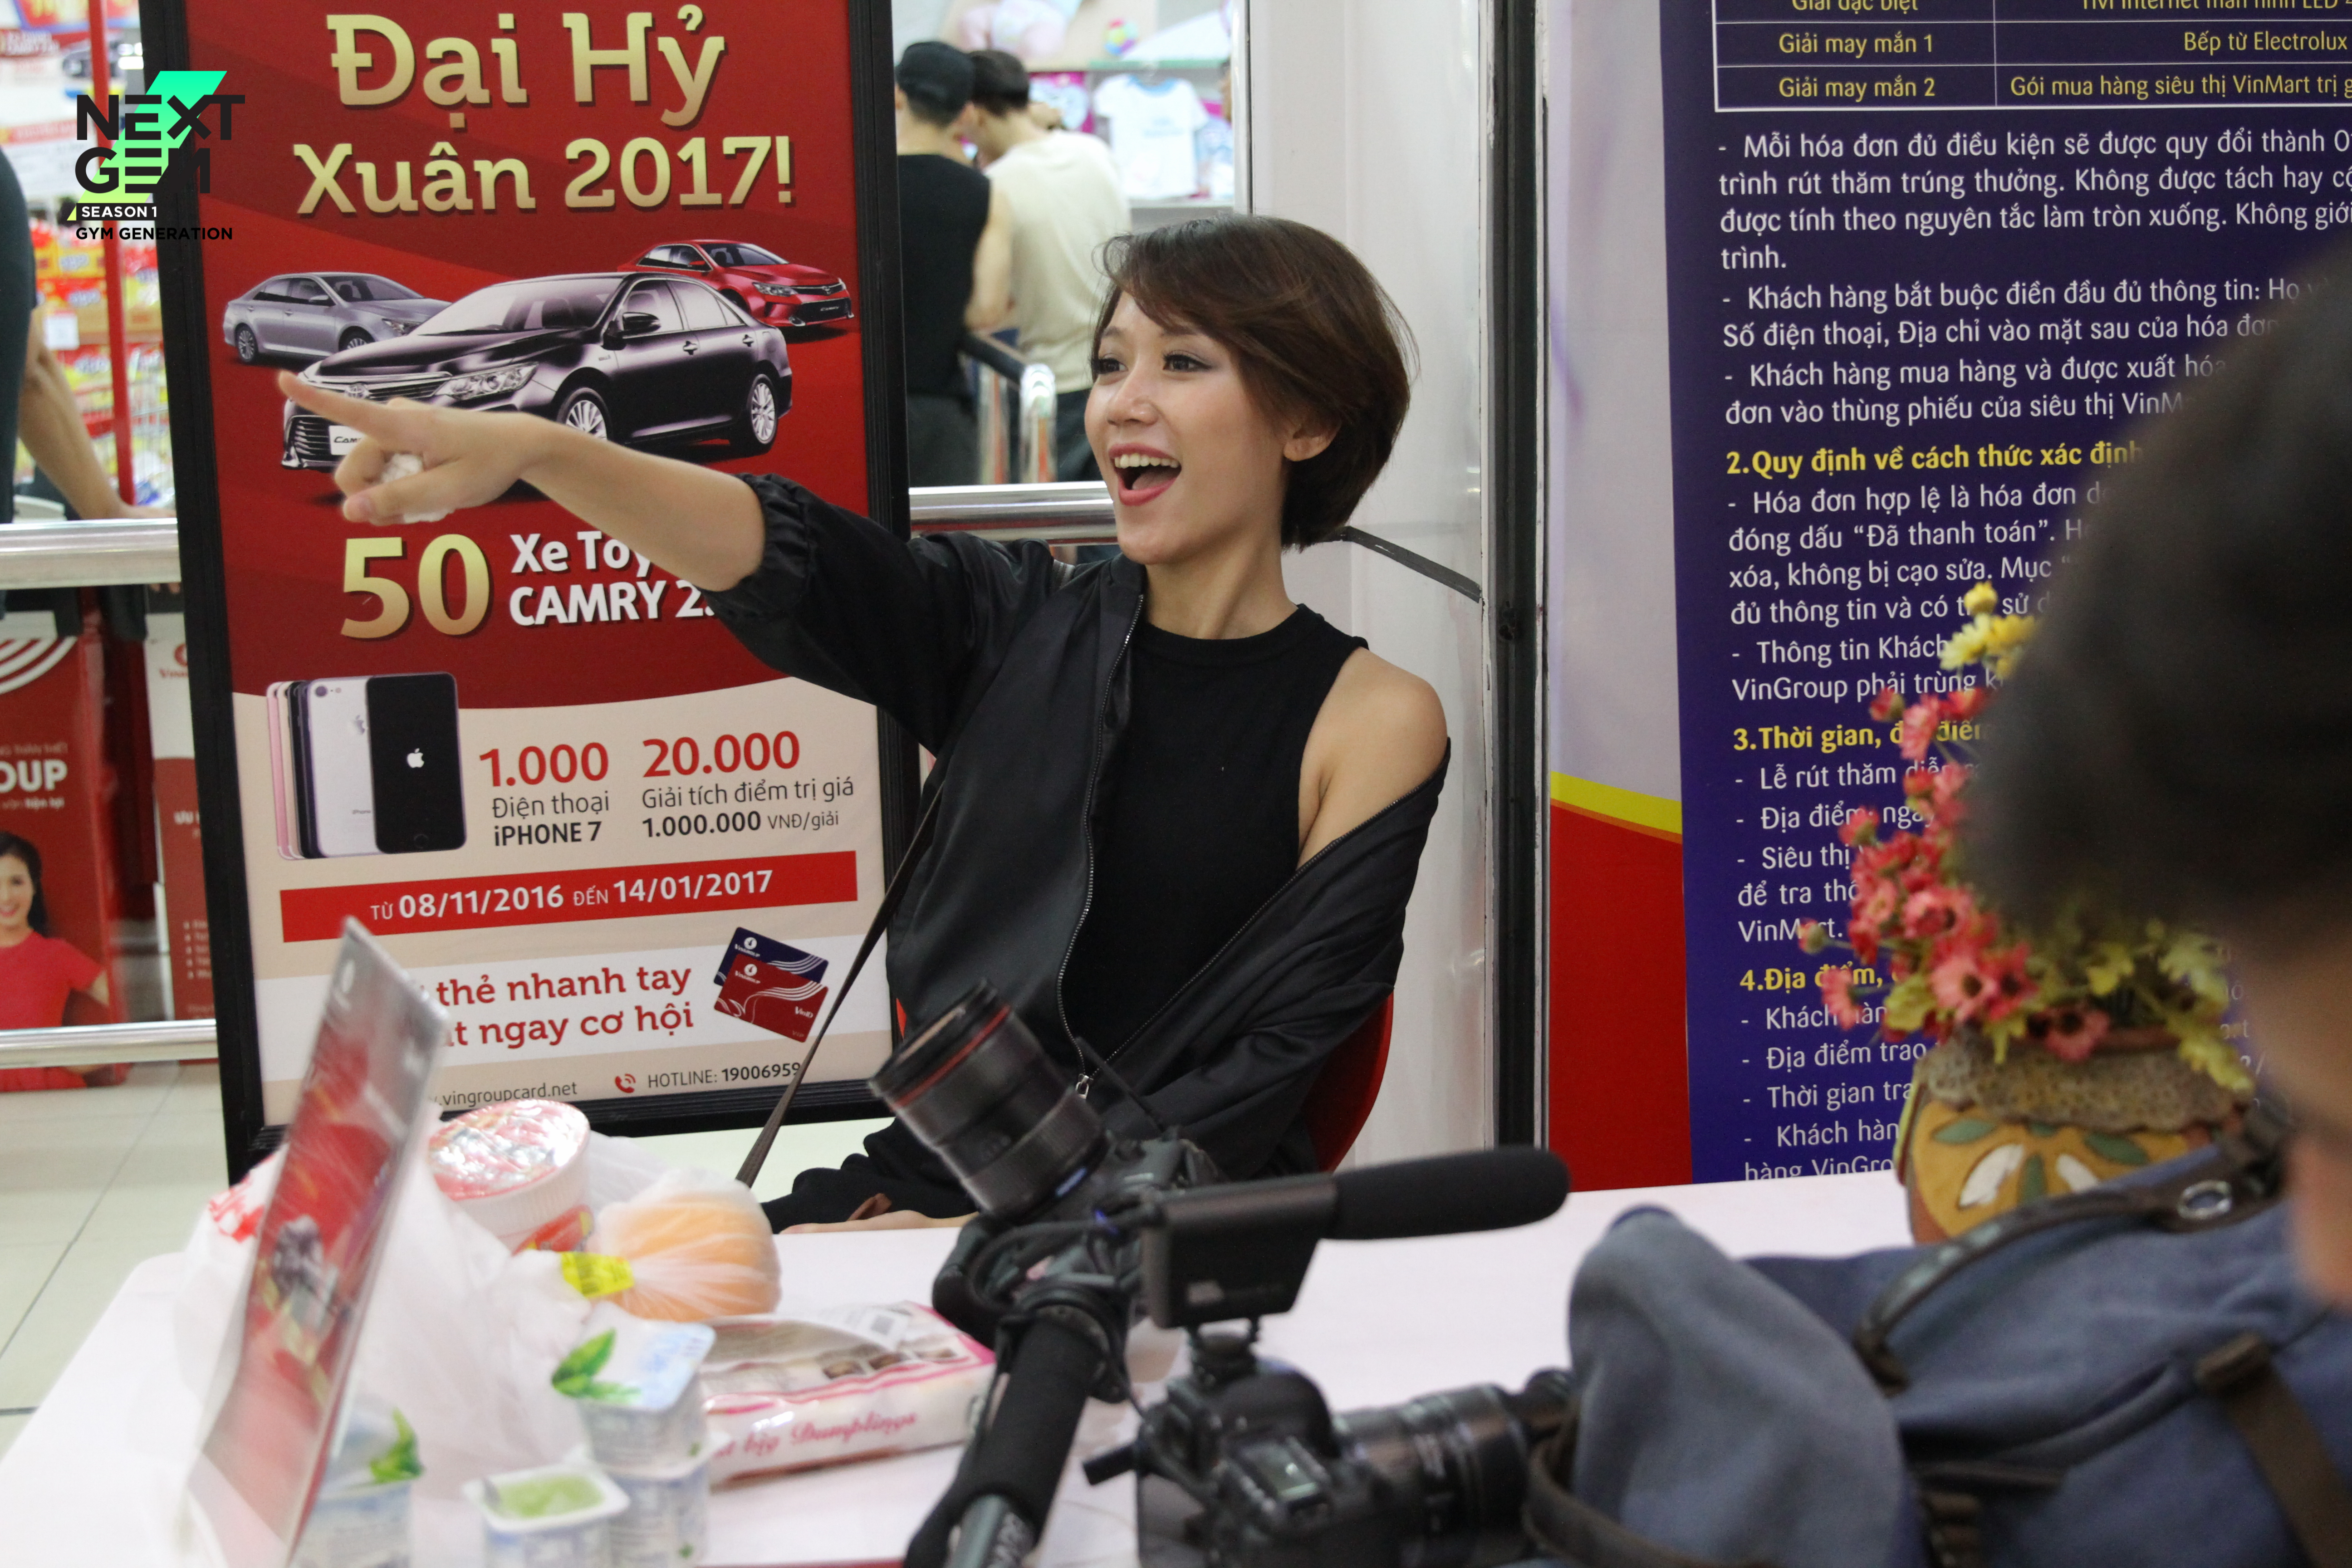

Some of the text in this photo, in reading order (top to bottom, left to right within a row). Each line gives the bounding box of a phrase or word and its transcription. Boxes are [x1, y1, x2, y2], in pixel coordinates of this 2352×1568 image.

[1779, 31, 1932, 59] Giải may mắn 1
[2184, 30, 2347, 56] Bếp từ Electrolux
[326, 4, 725, 127] Đại Hỷ
[1779, 75, 1935, 103] Giải may mắn 2
[2010, 74, 2337, 100] Gói mua hàng siêu thị VinMart trị
[1744, 127, 2324, 160] Mỗi hóa đơn đủ điều kiện sẽ được quy đổi thành
[293, 135, 791, 214] Xuân 2017!
[1719, 165, 2323, 200] trình rút thăm trúng thưởng. Không được tách hay
[1721, 244, 1786, 270] trình.
[1749, 278, 2259, 314] Khách hàng bắt buộc điền đầu đủ thông tin:
[1724, 322, 1754, 347] Số
[1764, 322, 1814, 350] điện
[1823, 321, 1889, 349] thoại,
[1897, 321, 1937, 348] Địa
[1945, 318, 1980, 343] chỉ
[1988, 318, 2030, 342] vào
[2039, 318, 2082, 345] mặt
[2091, 322, 2129, 339] sau
[2138, 316, 2177, 338] của
[2187, 314, 2228, 337] hóa
[1726, 442, 2082, 480] 2.Quy định về cách thức xác
[1754, 490, 1801, 514] Hóa
[1811, 488, 1856, 512] đơn
[1866, 487, 1911, 516] hợp
[1921, 485, 1940, 513] lệ
[1951, 485, 1969, 508] là
[1980, 484, 2022, 507] hóa
[2033, 482, 2076, 505] đơn
[510, 533, 568, 573] Xe
[1729, 527, 1791, 557] đóng
[1799, 524, 1842, 549] dấu
[1854, 524, 1898, 547] “Đã
[1908, 520, 1975, 546] thanh
[1984, 519, 2055, 543] toán”.
[342, 533, 490, 638] 50
[1730, 556, 2051, 591] xóa, không bị cạo sửa. Mục
[509, 580, 667, 626] CAMRY
[1731, 600, 1760, 625] đủ
[1769, 599, 1839, 628] thông
[1846, 598, 1877, 621] tin
[1885, 596, 1911, 619] và
[1920, 594, 1948, 618] có
[1756, 638, 1869, 668] Thông tin
[1732, 676, 1848, 704] VinGroup
[642, 730, 800, 778] 20.000
[1734, 725, 1813, 751] 3.Thời
[1821, 724, 1881, 754] gian,
[479, 742, 609, 787] 1.000
[1760, 764, 1787, 789] Lễ
[1796, 764, 1829, 788] rút
[1837, 762, 1896, 786] thăm
[491, 790, 609, 820] Điện thoại
[642, 775, 854, 809] Giải tích điểm trị giá
[494, 820, 602, 847] iPHONE 7
[642, 810, 839, 838] 1.000.000 VNĐ/giải
[1760, 807, 1800, 833] Địa
[1762, 843, 1850, 870] Siêu thị
[370, 869, 773, 920] TỪ 08/11/2016 ĐẾN 14/01/2017
[1738, 880, 1767, 906] để
[1779, 884, 1811, 905] tra
[436, 966, 692, 1007] thẻ nhanh tay
[1740, 967, 1806, 994] 4.Địa
[479, 1018, 569, 1049] ngay
[580, 1010, 624, 1036] cơ
[634, 1001, 694, 1036] hội
[1766, 1046, 1805, 1073] Địa
[1814, 1039, 1871, 1066] điểm
[436, 1082, 578, 1108] .vingroupcard.net
[648, 1069, 717, 1088] HOTLINE:
[1767, 1084, 1818, 1108] Thời
[1827, 1082, 1874, 1111] gian
[1777, 1120, 1848, 1147] Khách
